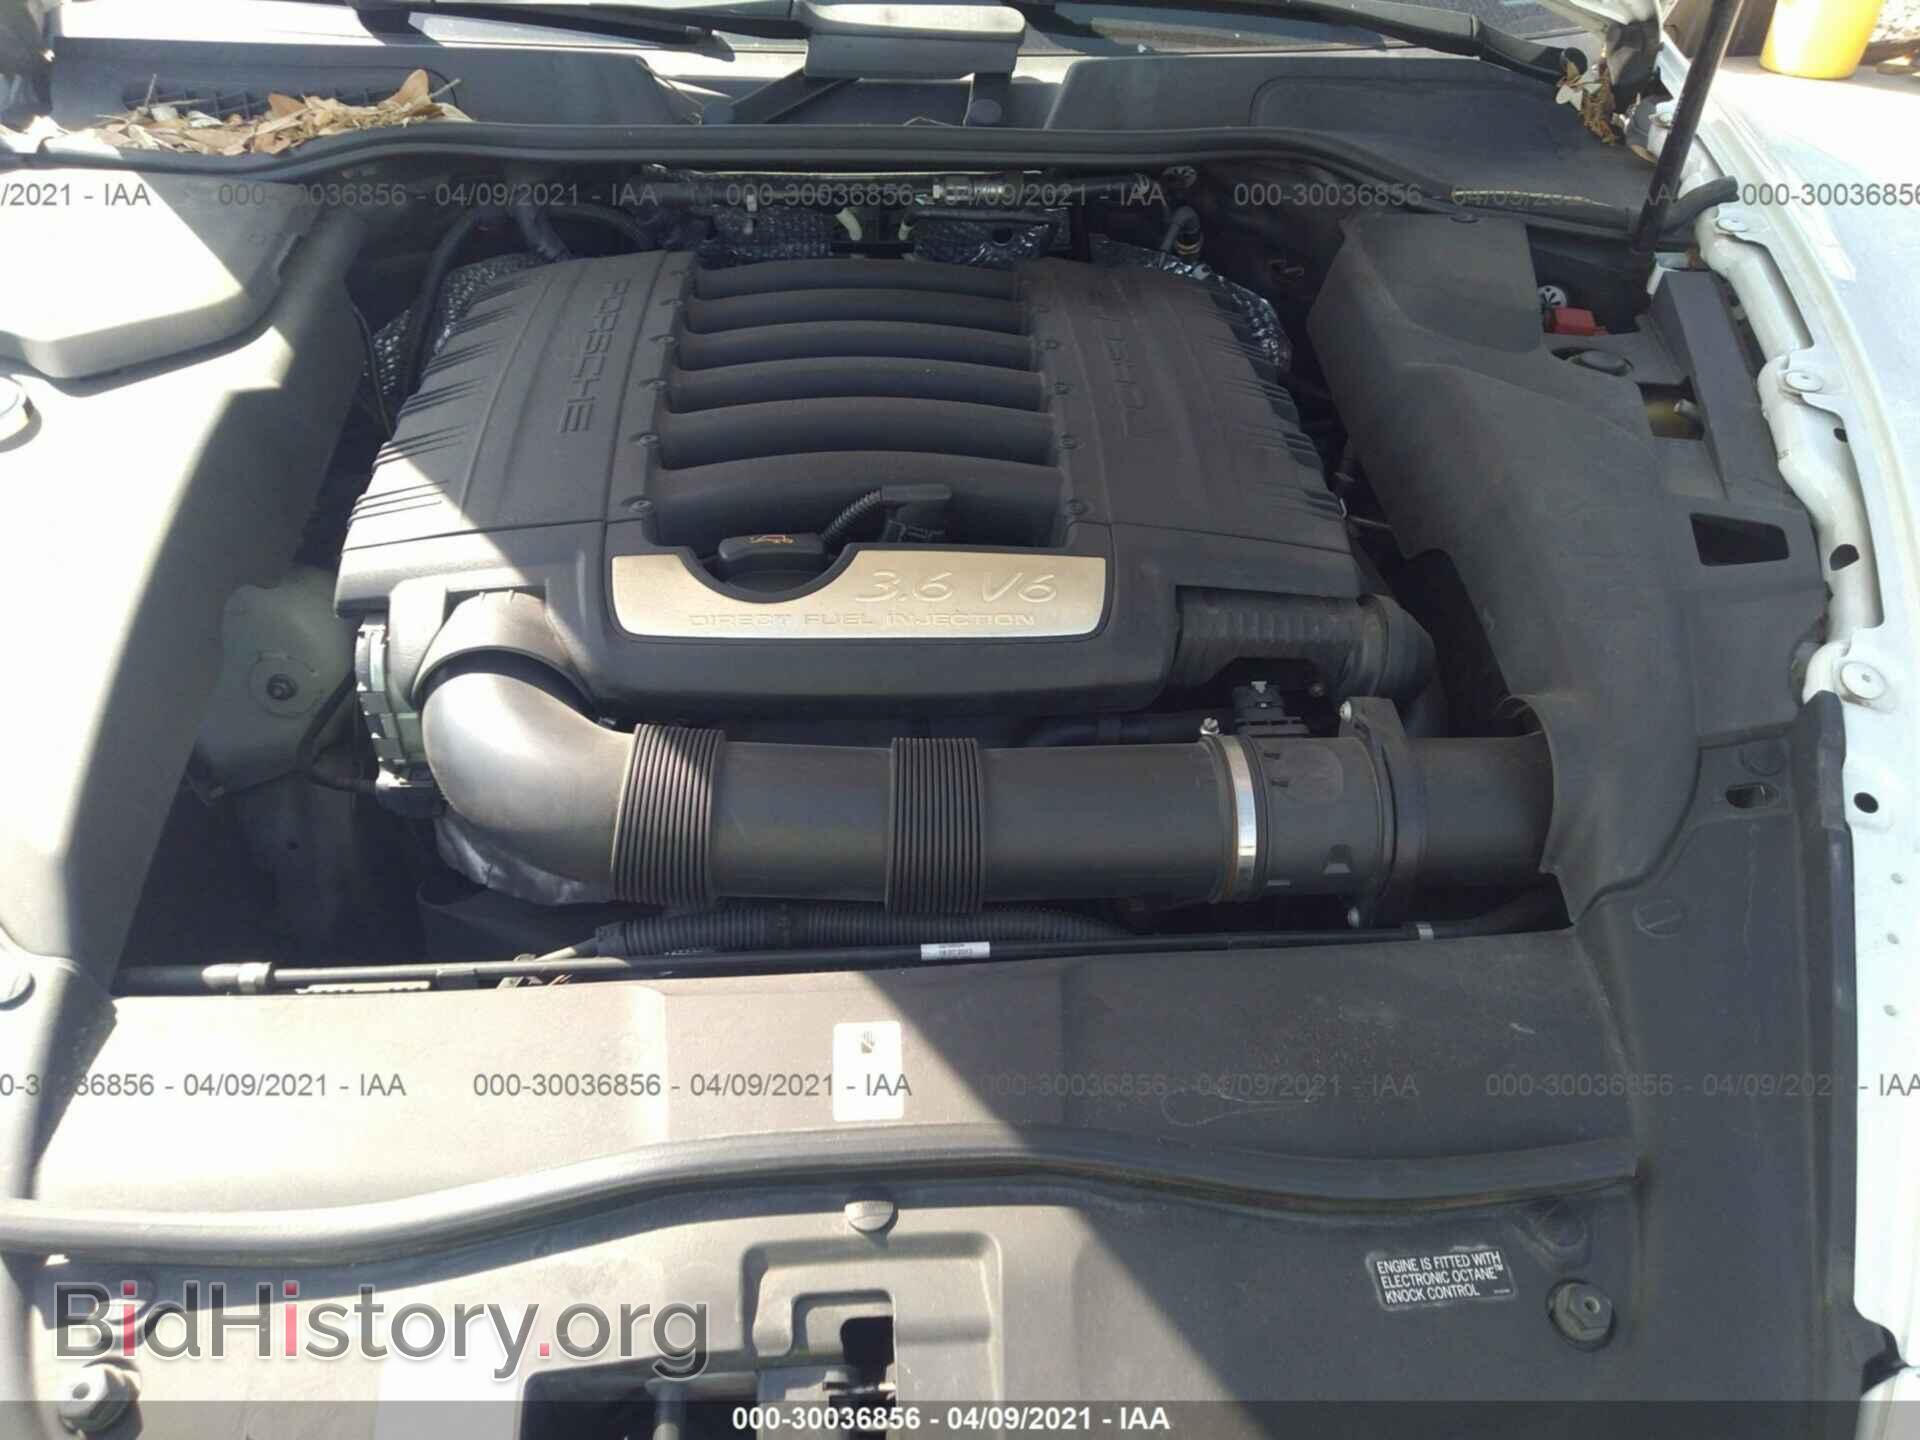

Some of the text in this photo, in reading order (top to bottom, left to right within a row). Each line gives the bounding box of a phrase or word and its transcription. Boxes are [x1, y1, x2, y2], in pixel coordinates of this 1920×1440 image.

[560, 278, 632, 433] PORSCHE
[856, 571, 1058, 603] 3.6 V6
[689, 612, 1035, 627] DIRECT FUEL INJECTION
[1376, 1251, 1501, 1274] ENGINE IS FITTED WITH
[1380, 1271, 1450, 1288] ELECTRONIC
[1385, 1287, 1426, 1304] KNOCK
[1427, 1283, 1480, 1300] CONTROL
